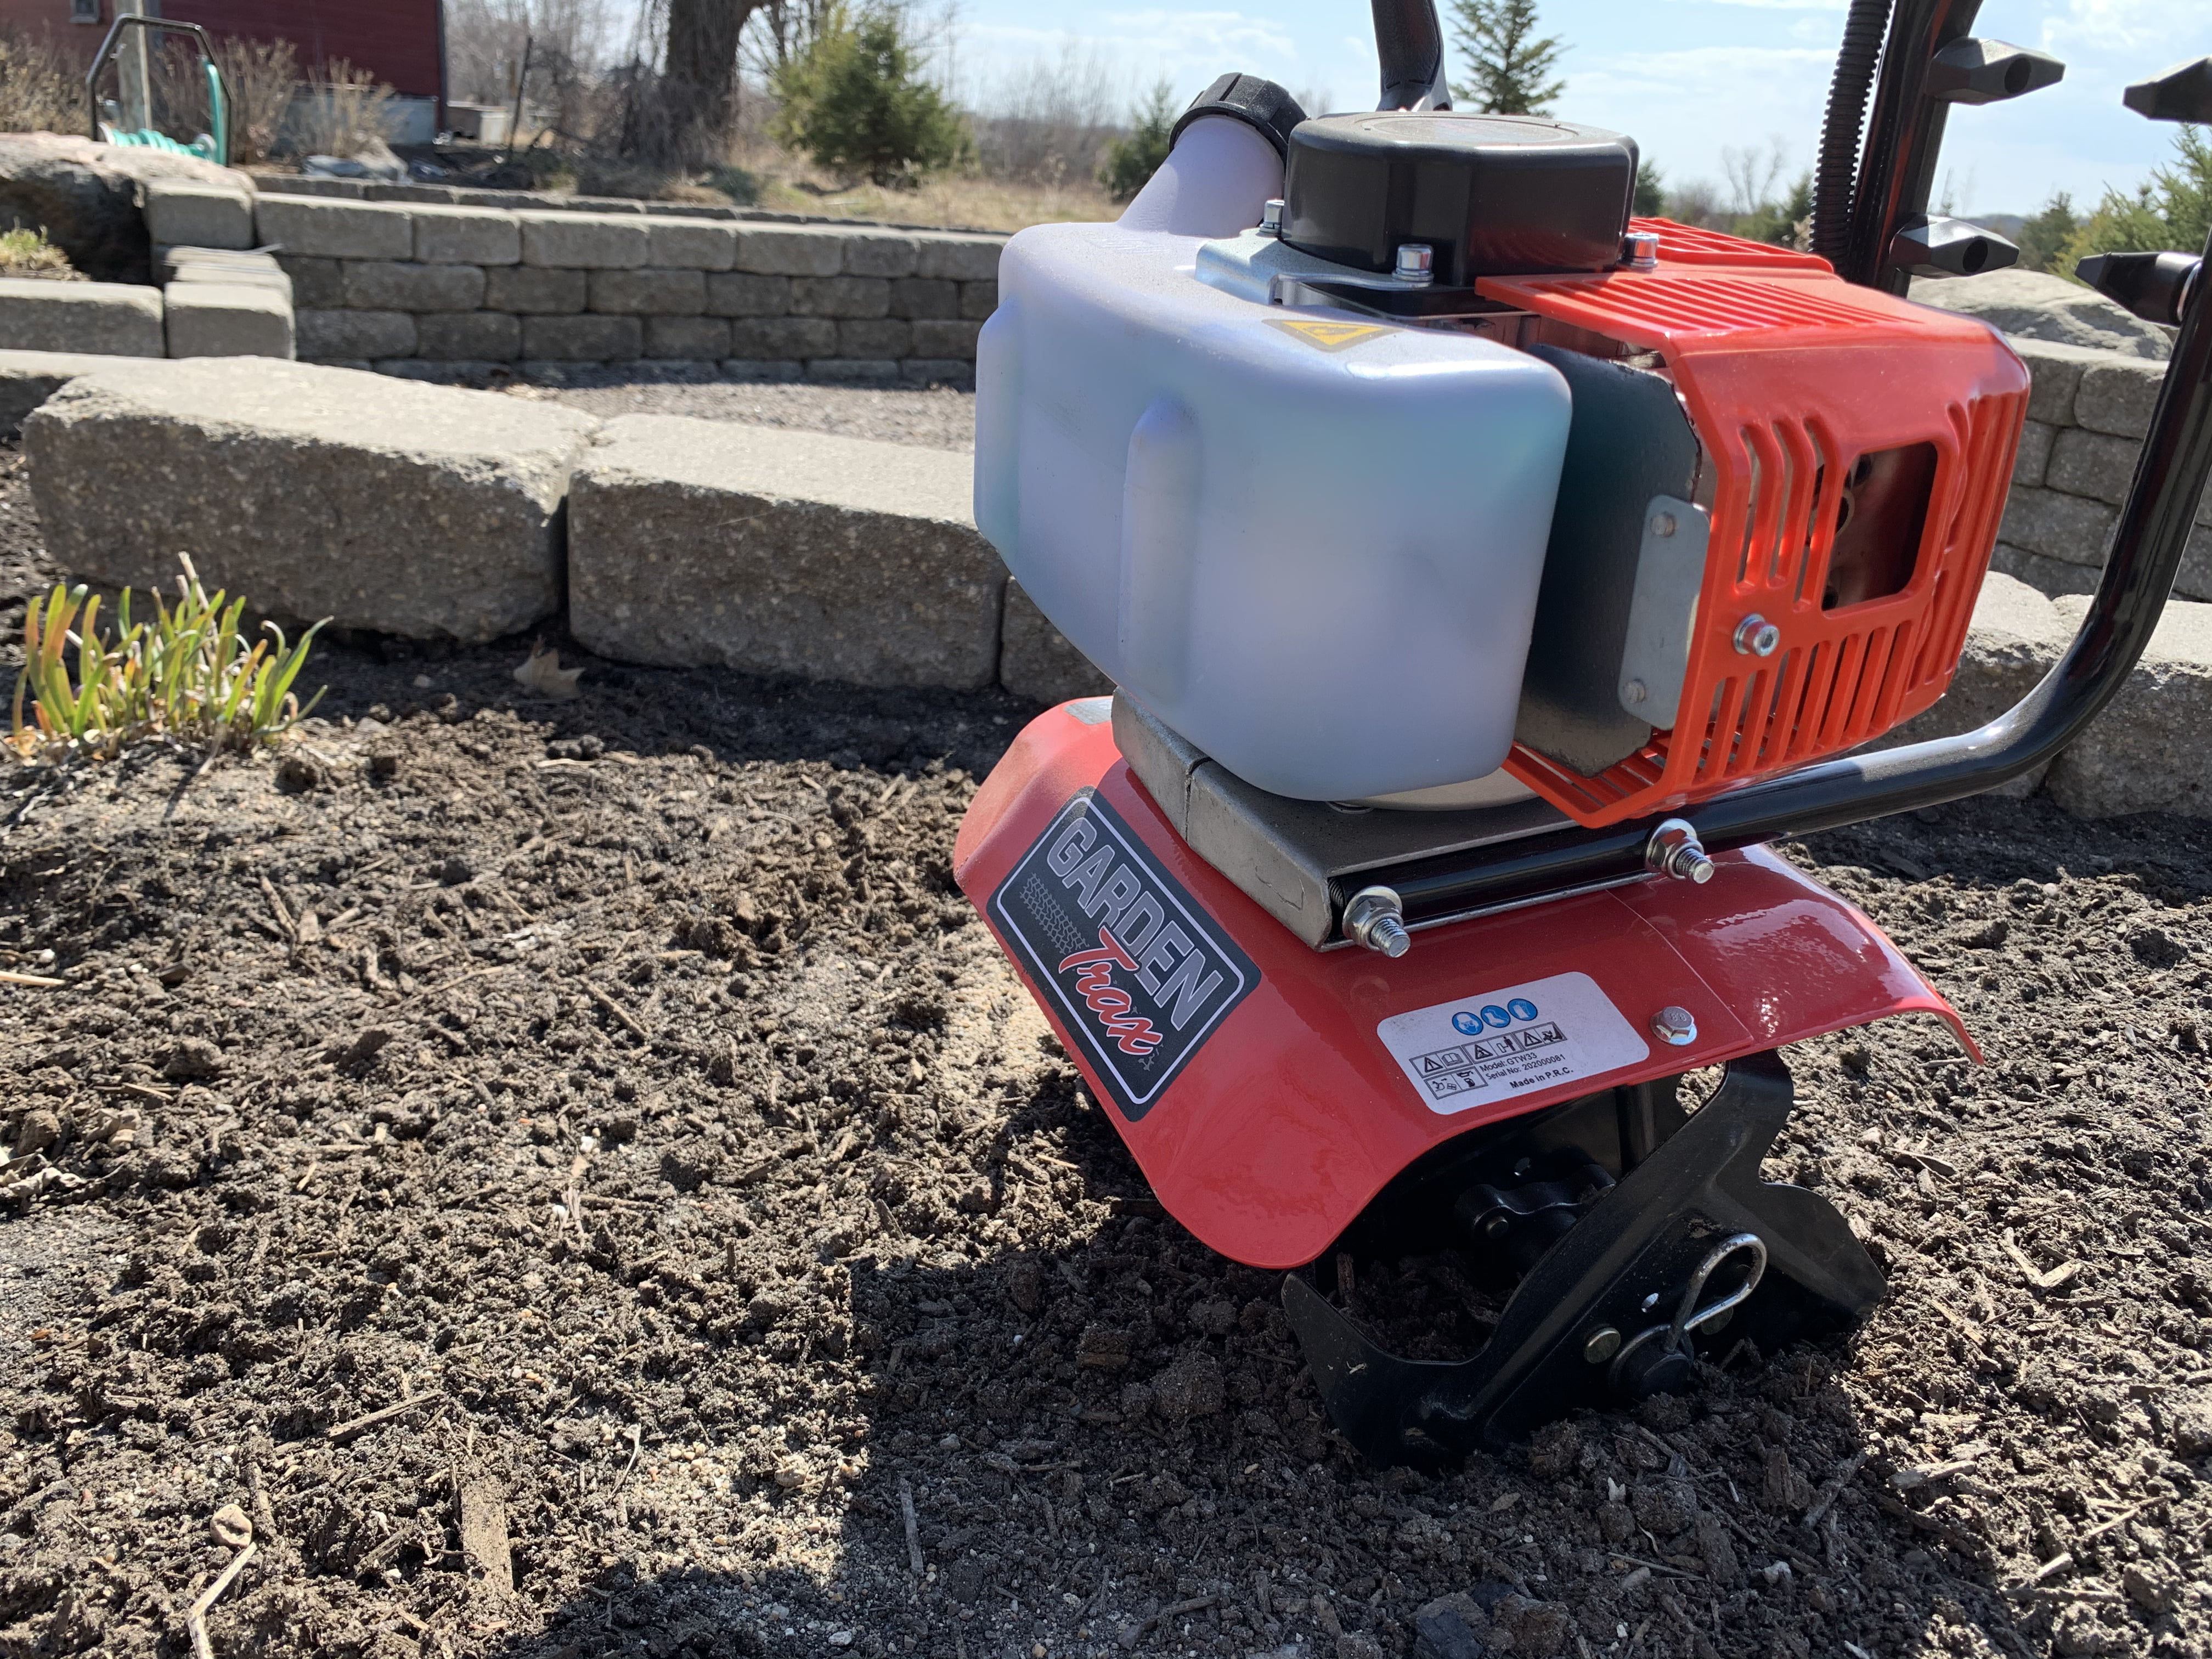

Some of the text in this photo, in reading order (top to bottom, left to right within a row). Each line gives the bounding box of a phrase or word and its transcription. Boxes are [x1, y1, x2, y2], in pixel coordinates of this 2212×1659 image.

[1047, 817, 1223, 1031] GARDEN
[1058, 926, 1163, 1056] Trax
[1479, 1052, 1537, 1072] Model: GTW33
[1486, 1069, 1508, 1080] Serial
[1522, 1054, 1566, 1070] 202000081
[1509, 1077, 1535, 1088] Made
[1545, 1066, 1573, 1079] P.R.C.
